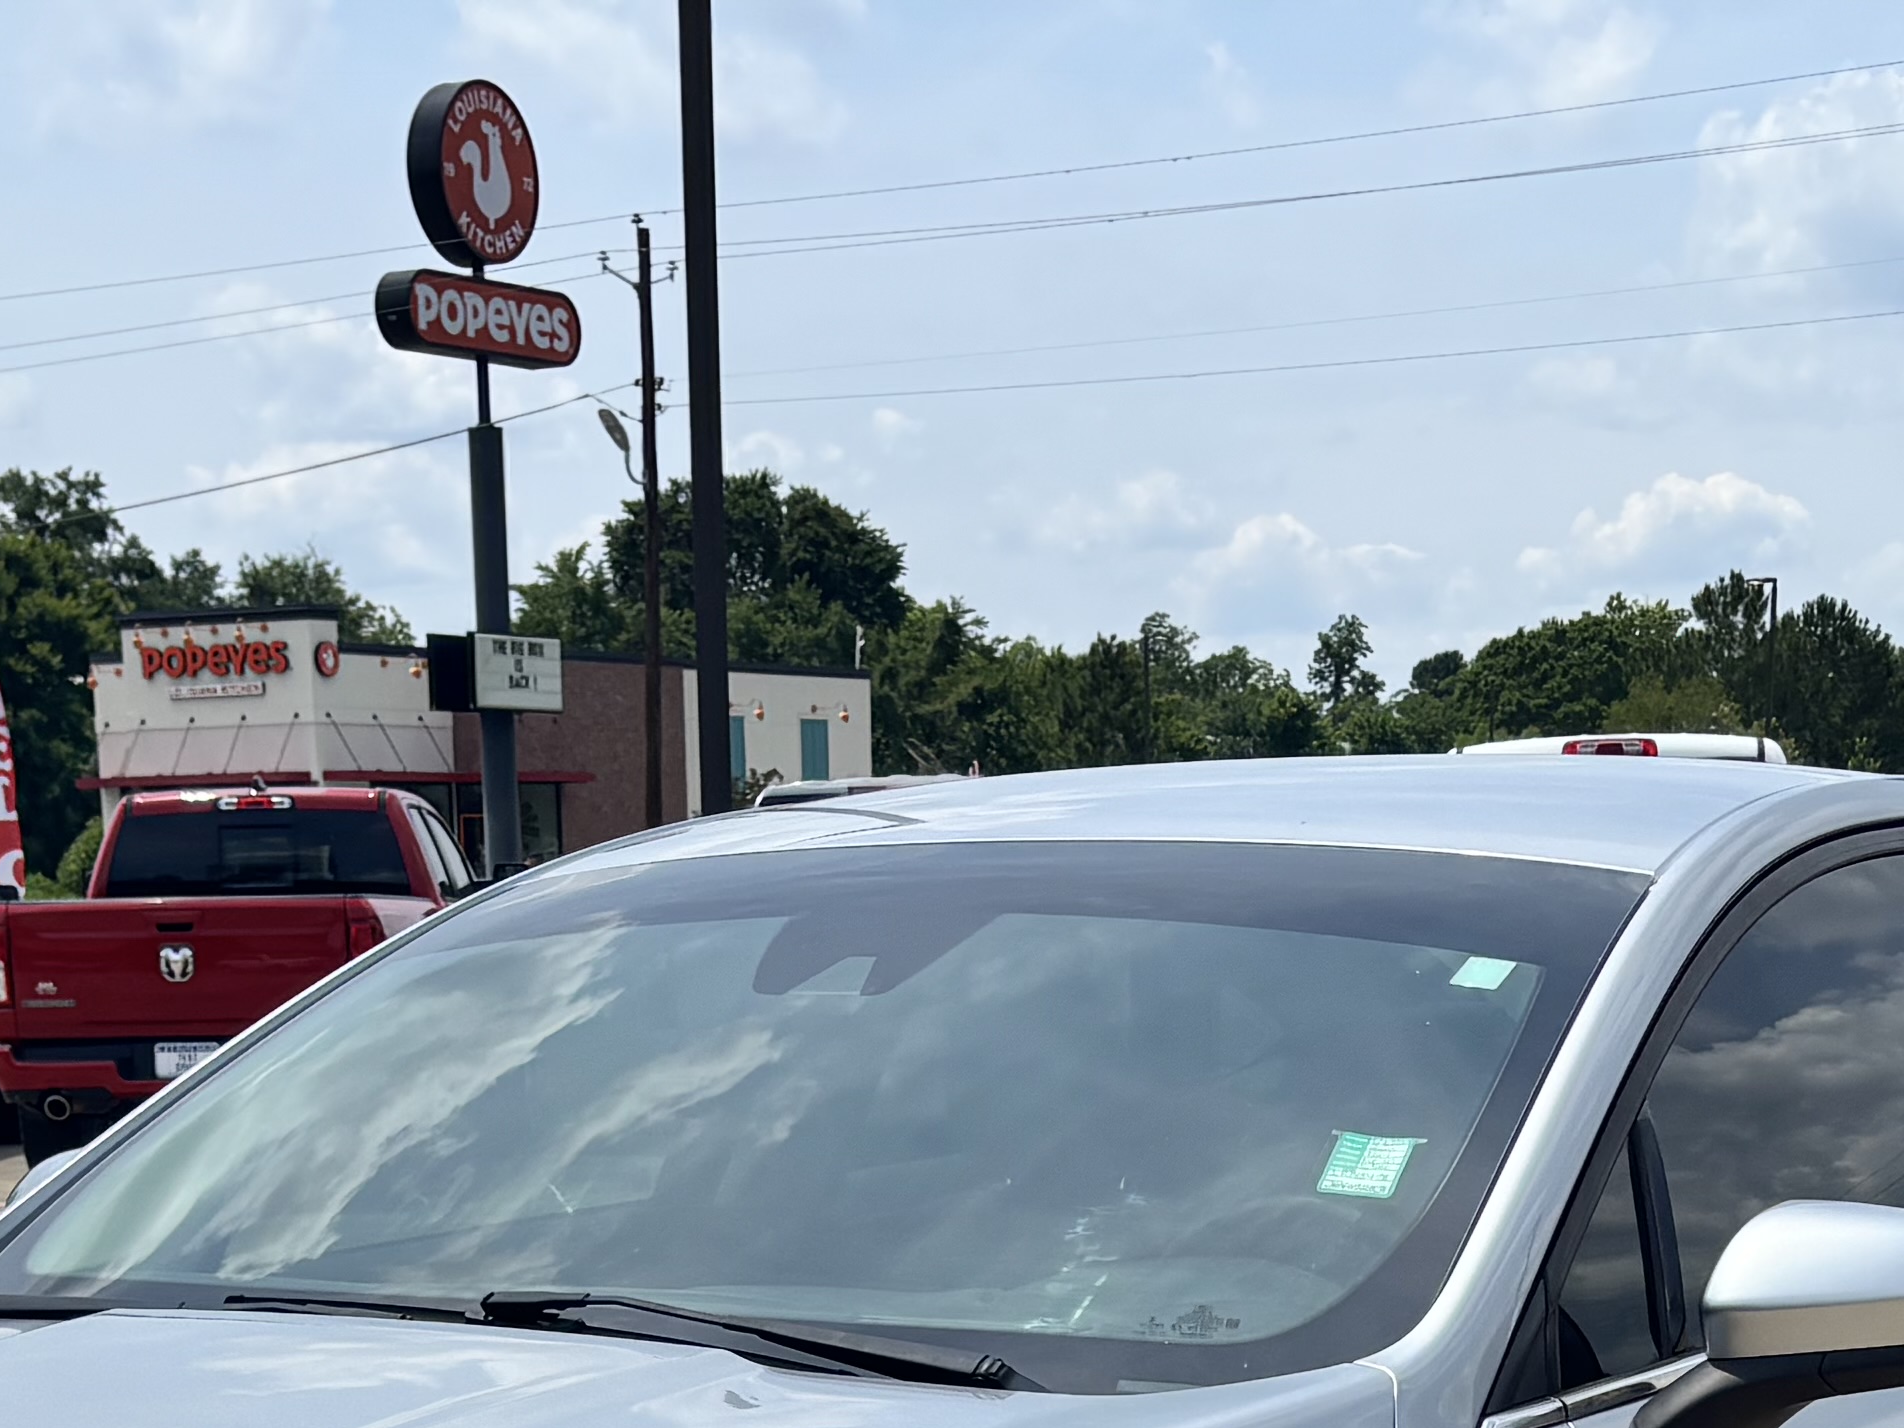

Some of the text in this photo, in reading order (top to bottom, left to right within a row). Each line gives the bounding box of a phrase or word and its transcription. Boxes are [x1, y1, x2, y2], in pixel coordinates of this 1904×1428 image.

[447, 89, 525, 146] LOUISIANA
[522, 176, 534, 193] 72
[456, 210, 526, 255] KITCHEN
